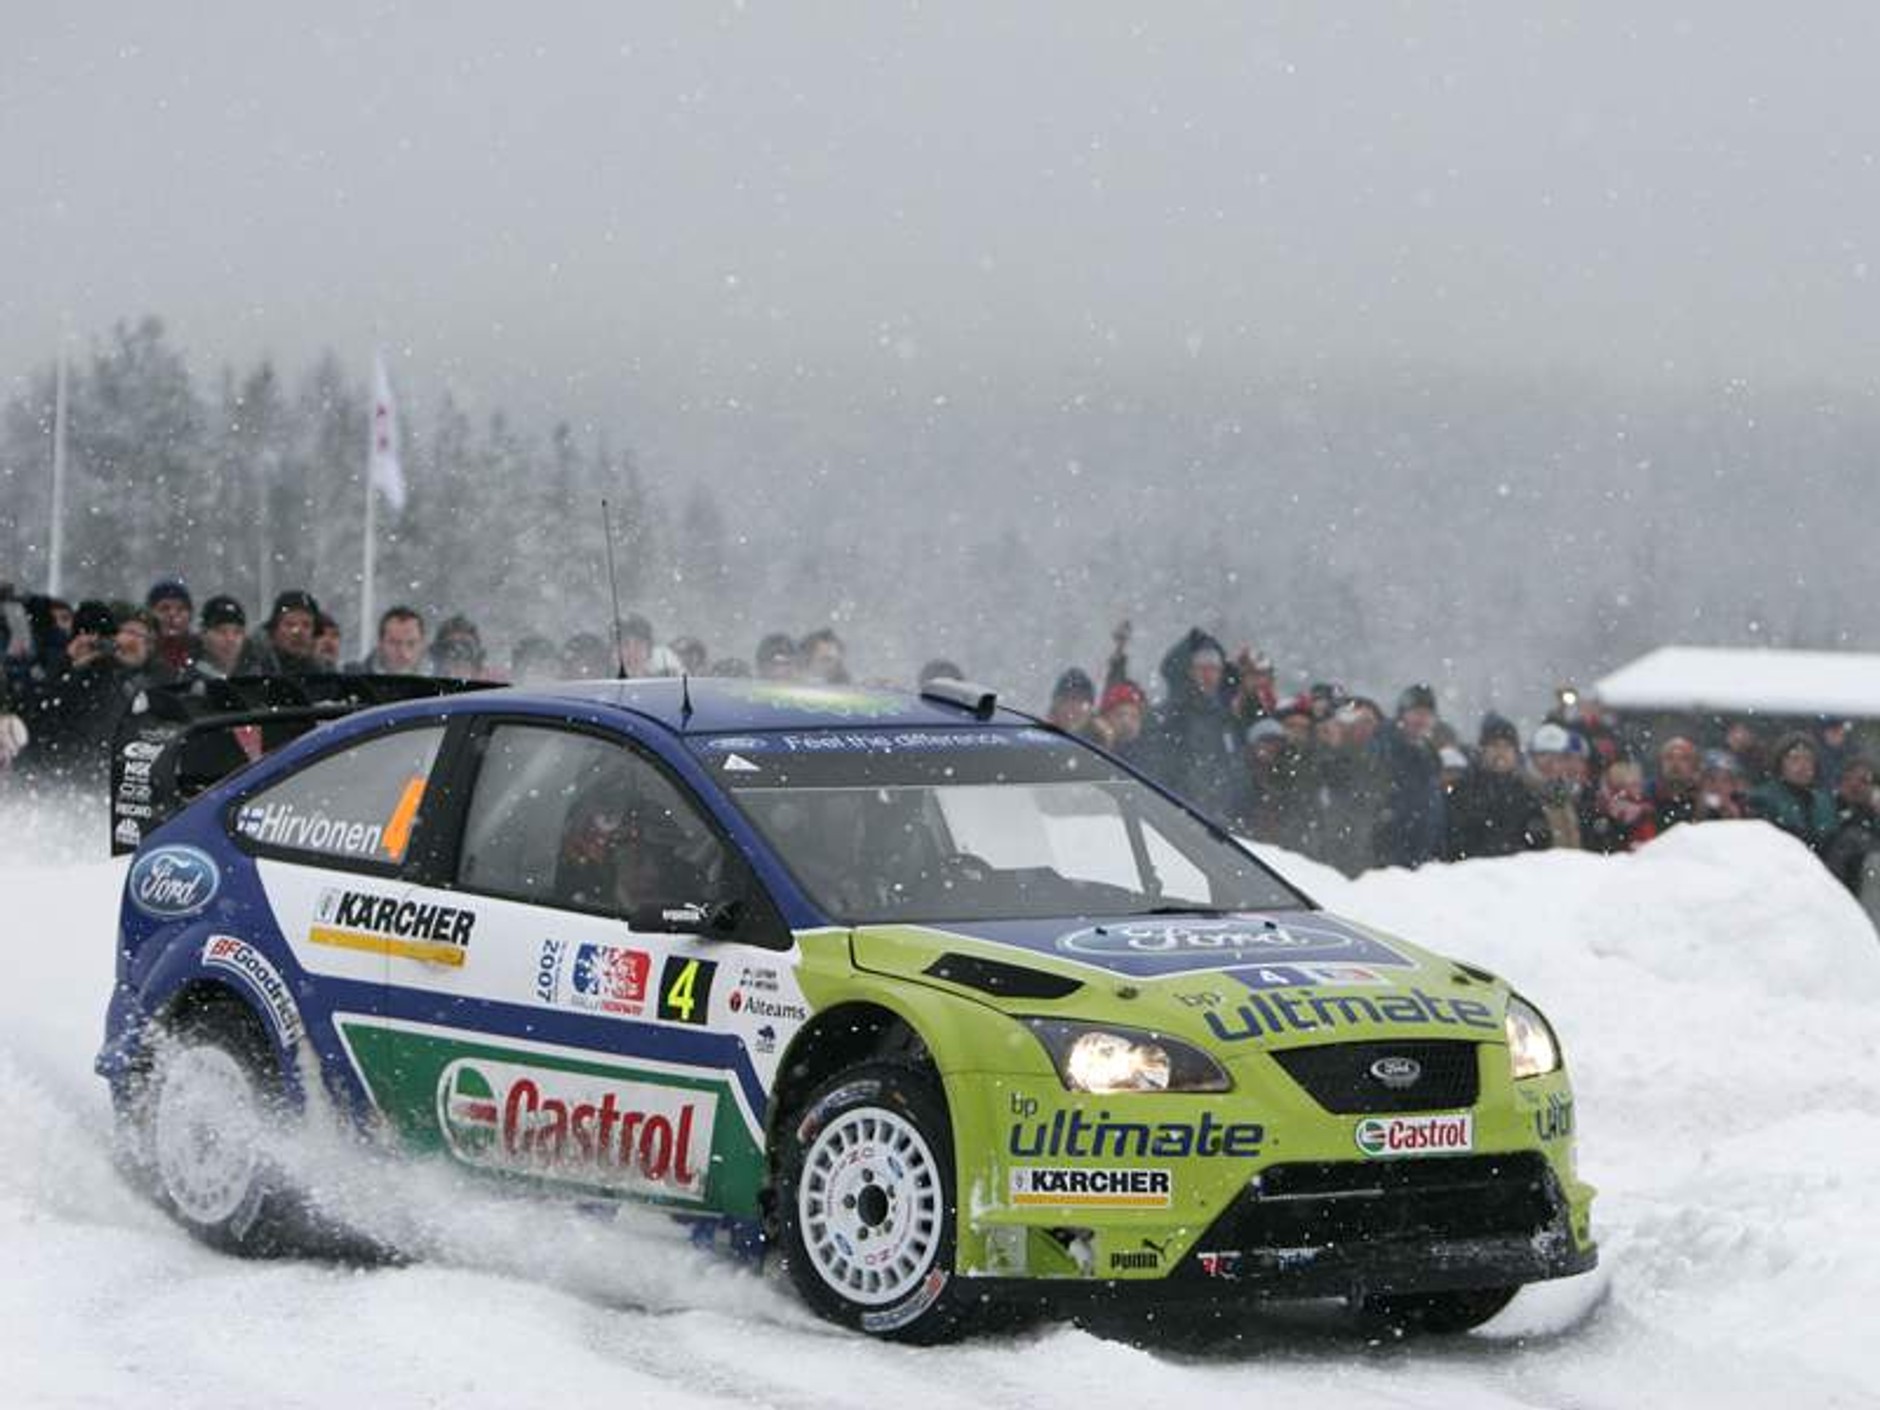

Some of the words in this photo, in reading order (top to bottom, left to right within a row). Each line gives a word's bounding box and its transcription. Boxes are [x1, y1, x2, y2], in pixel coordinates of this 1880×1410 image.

[257, 802, 383, 855] Hirvonen
[140, 854, 204, 905] Ford
[335, 890, 476, 946] KÄRCHER
[1123, 920, 1298, 949] Ford
[536, 938, 560, 1003] 2007
[666, 958, 700, 1021] 4
[1259, 967, 1290, 984] 4
[743, 995, 806, 1020] Alteams
[1203, 987, 1498, 1041] ultimate
[1011, 1091, 1039, 1119] bp
[503, 1078, 696, 1186] Castrol
[1010, 1108, 1265, 1158] ultimate
[1388, 1118, 1468, 1150] Castrol
[1031, 1170, 1170, 1193] KÄRCHER
